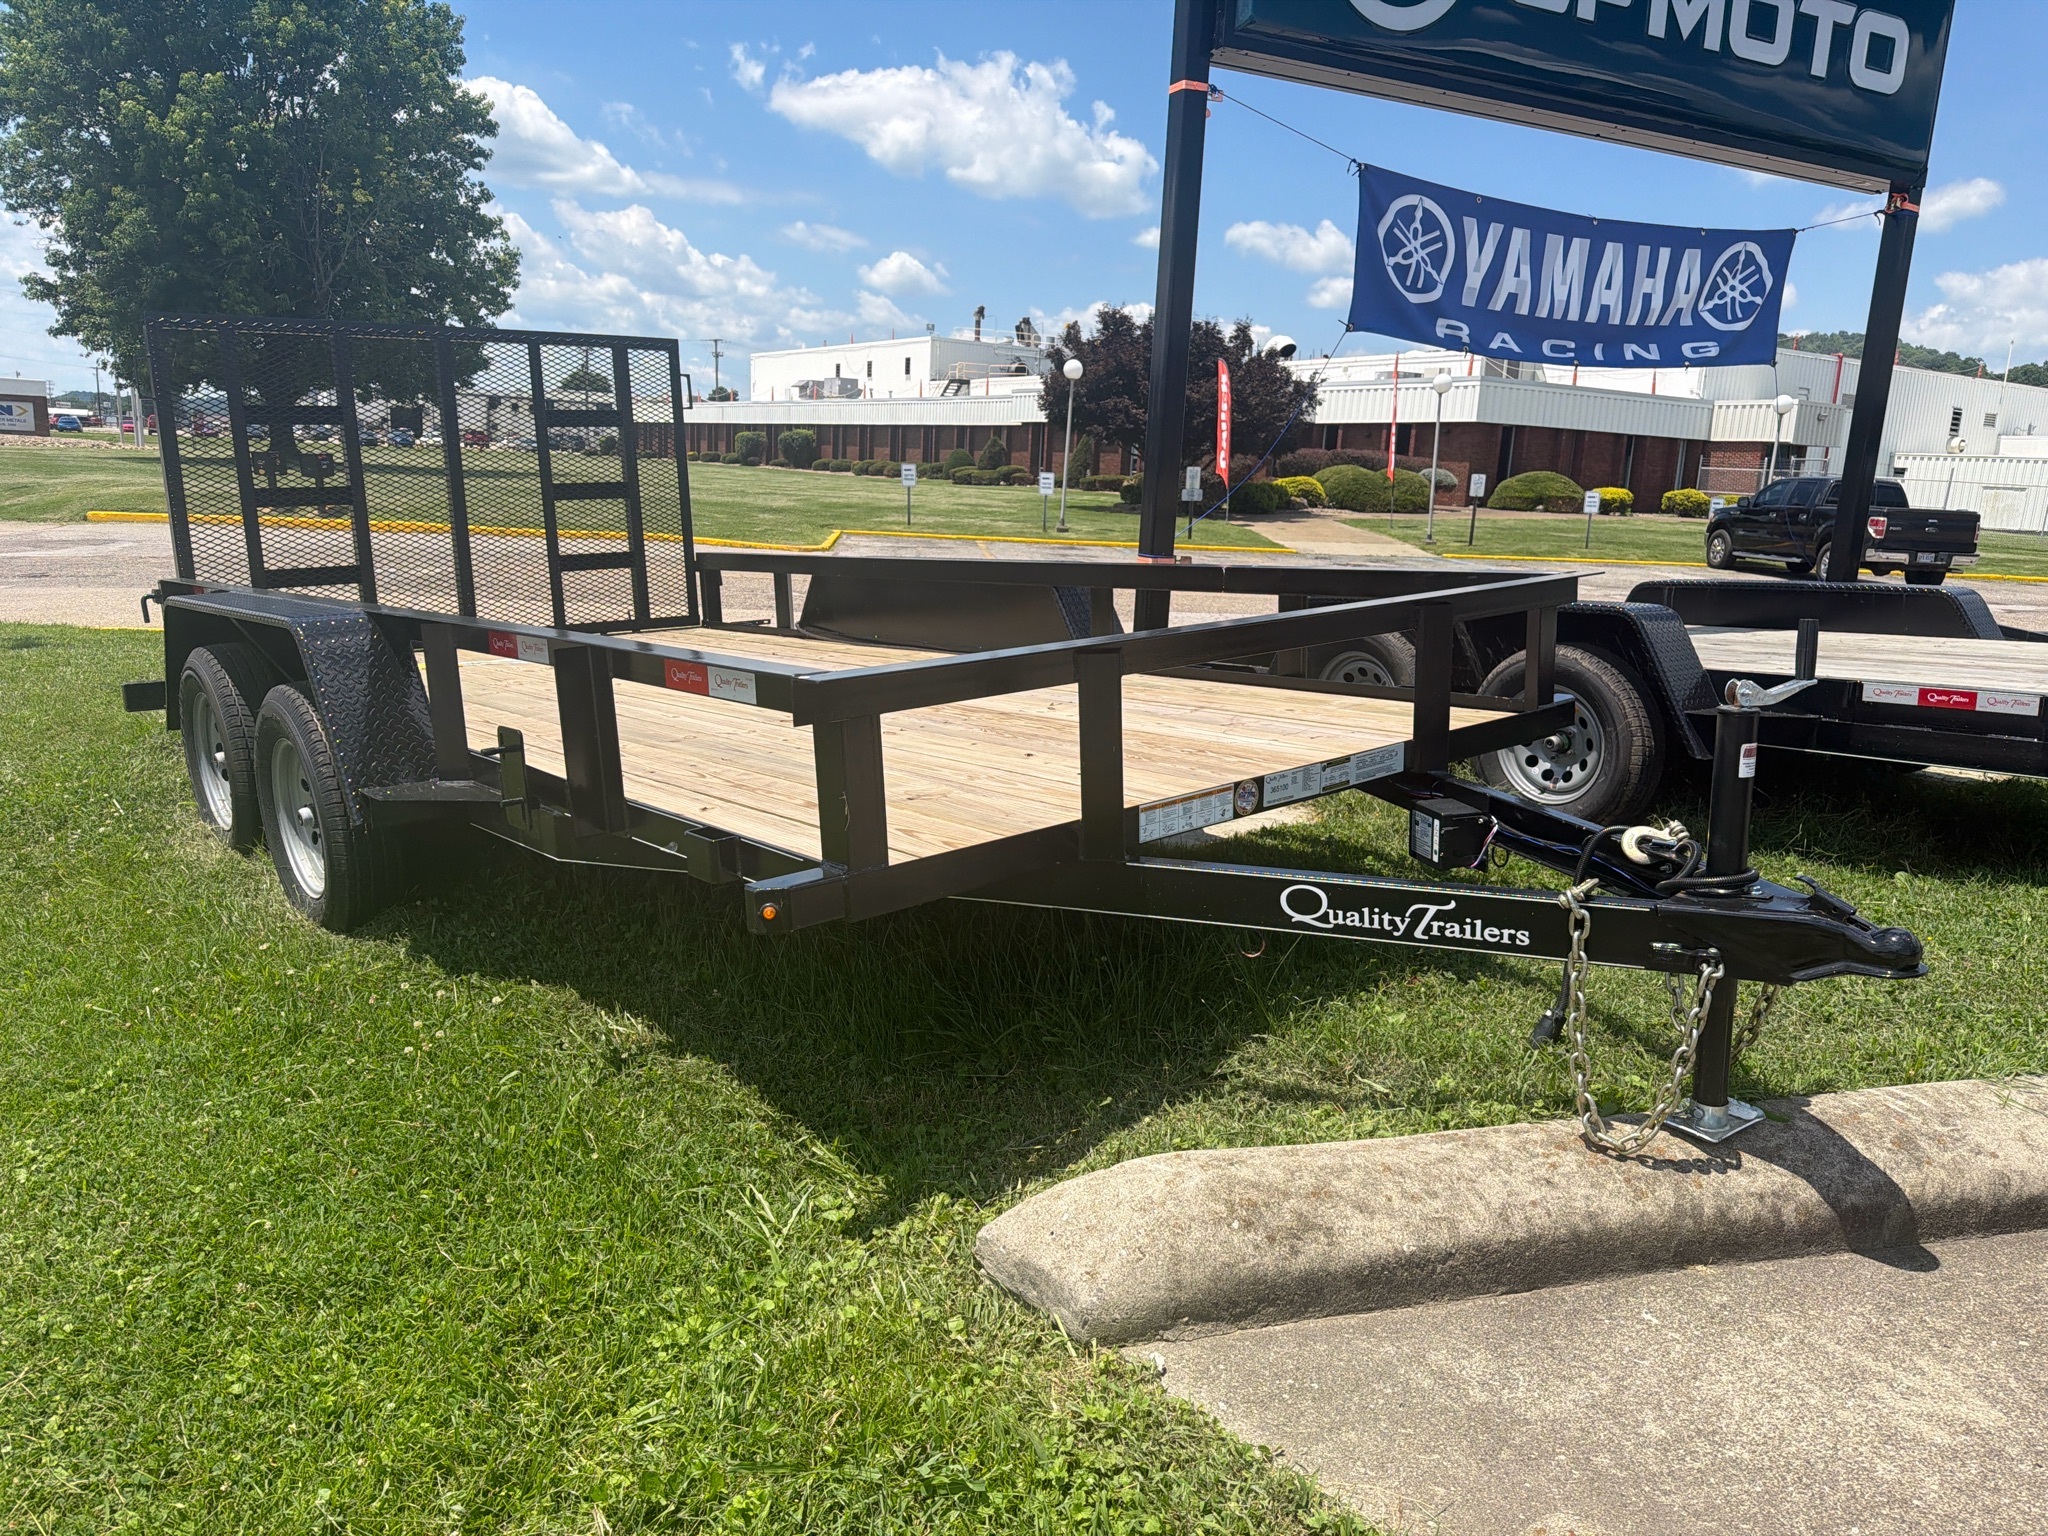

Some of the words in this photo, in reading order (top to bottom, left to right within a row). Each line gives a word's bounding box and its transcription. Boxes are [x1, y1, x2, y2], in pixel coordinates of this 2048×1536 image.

[1461, 216, 1702, 326] YAMAHA
[1435, 317, 1721, 360] RACING
[1872, 687, 1893, 698] Quality
[1927, 692, 1949, 703] Quality
[1986, 696, 2010, 707] Quality
[1279, 884, 1411, 937] Quality
[1405, 899, 1530, 946] Trailers
